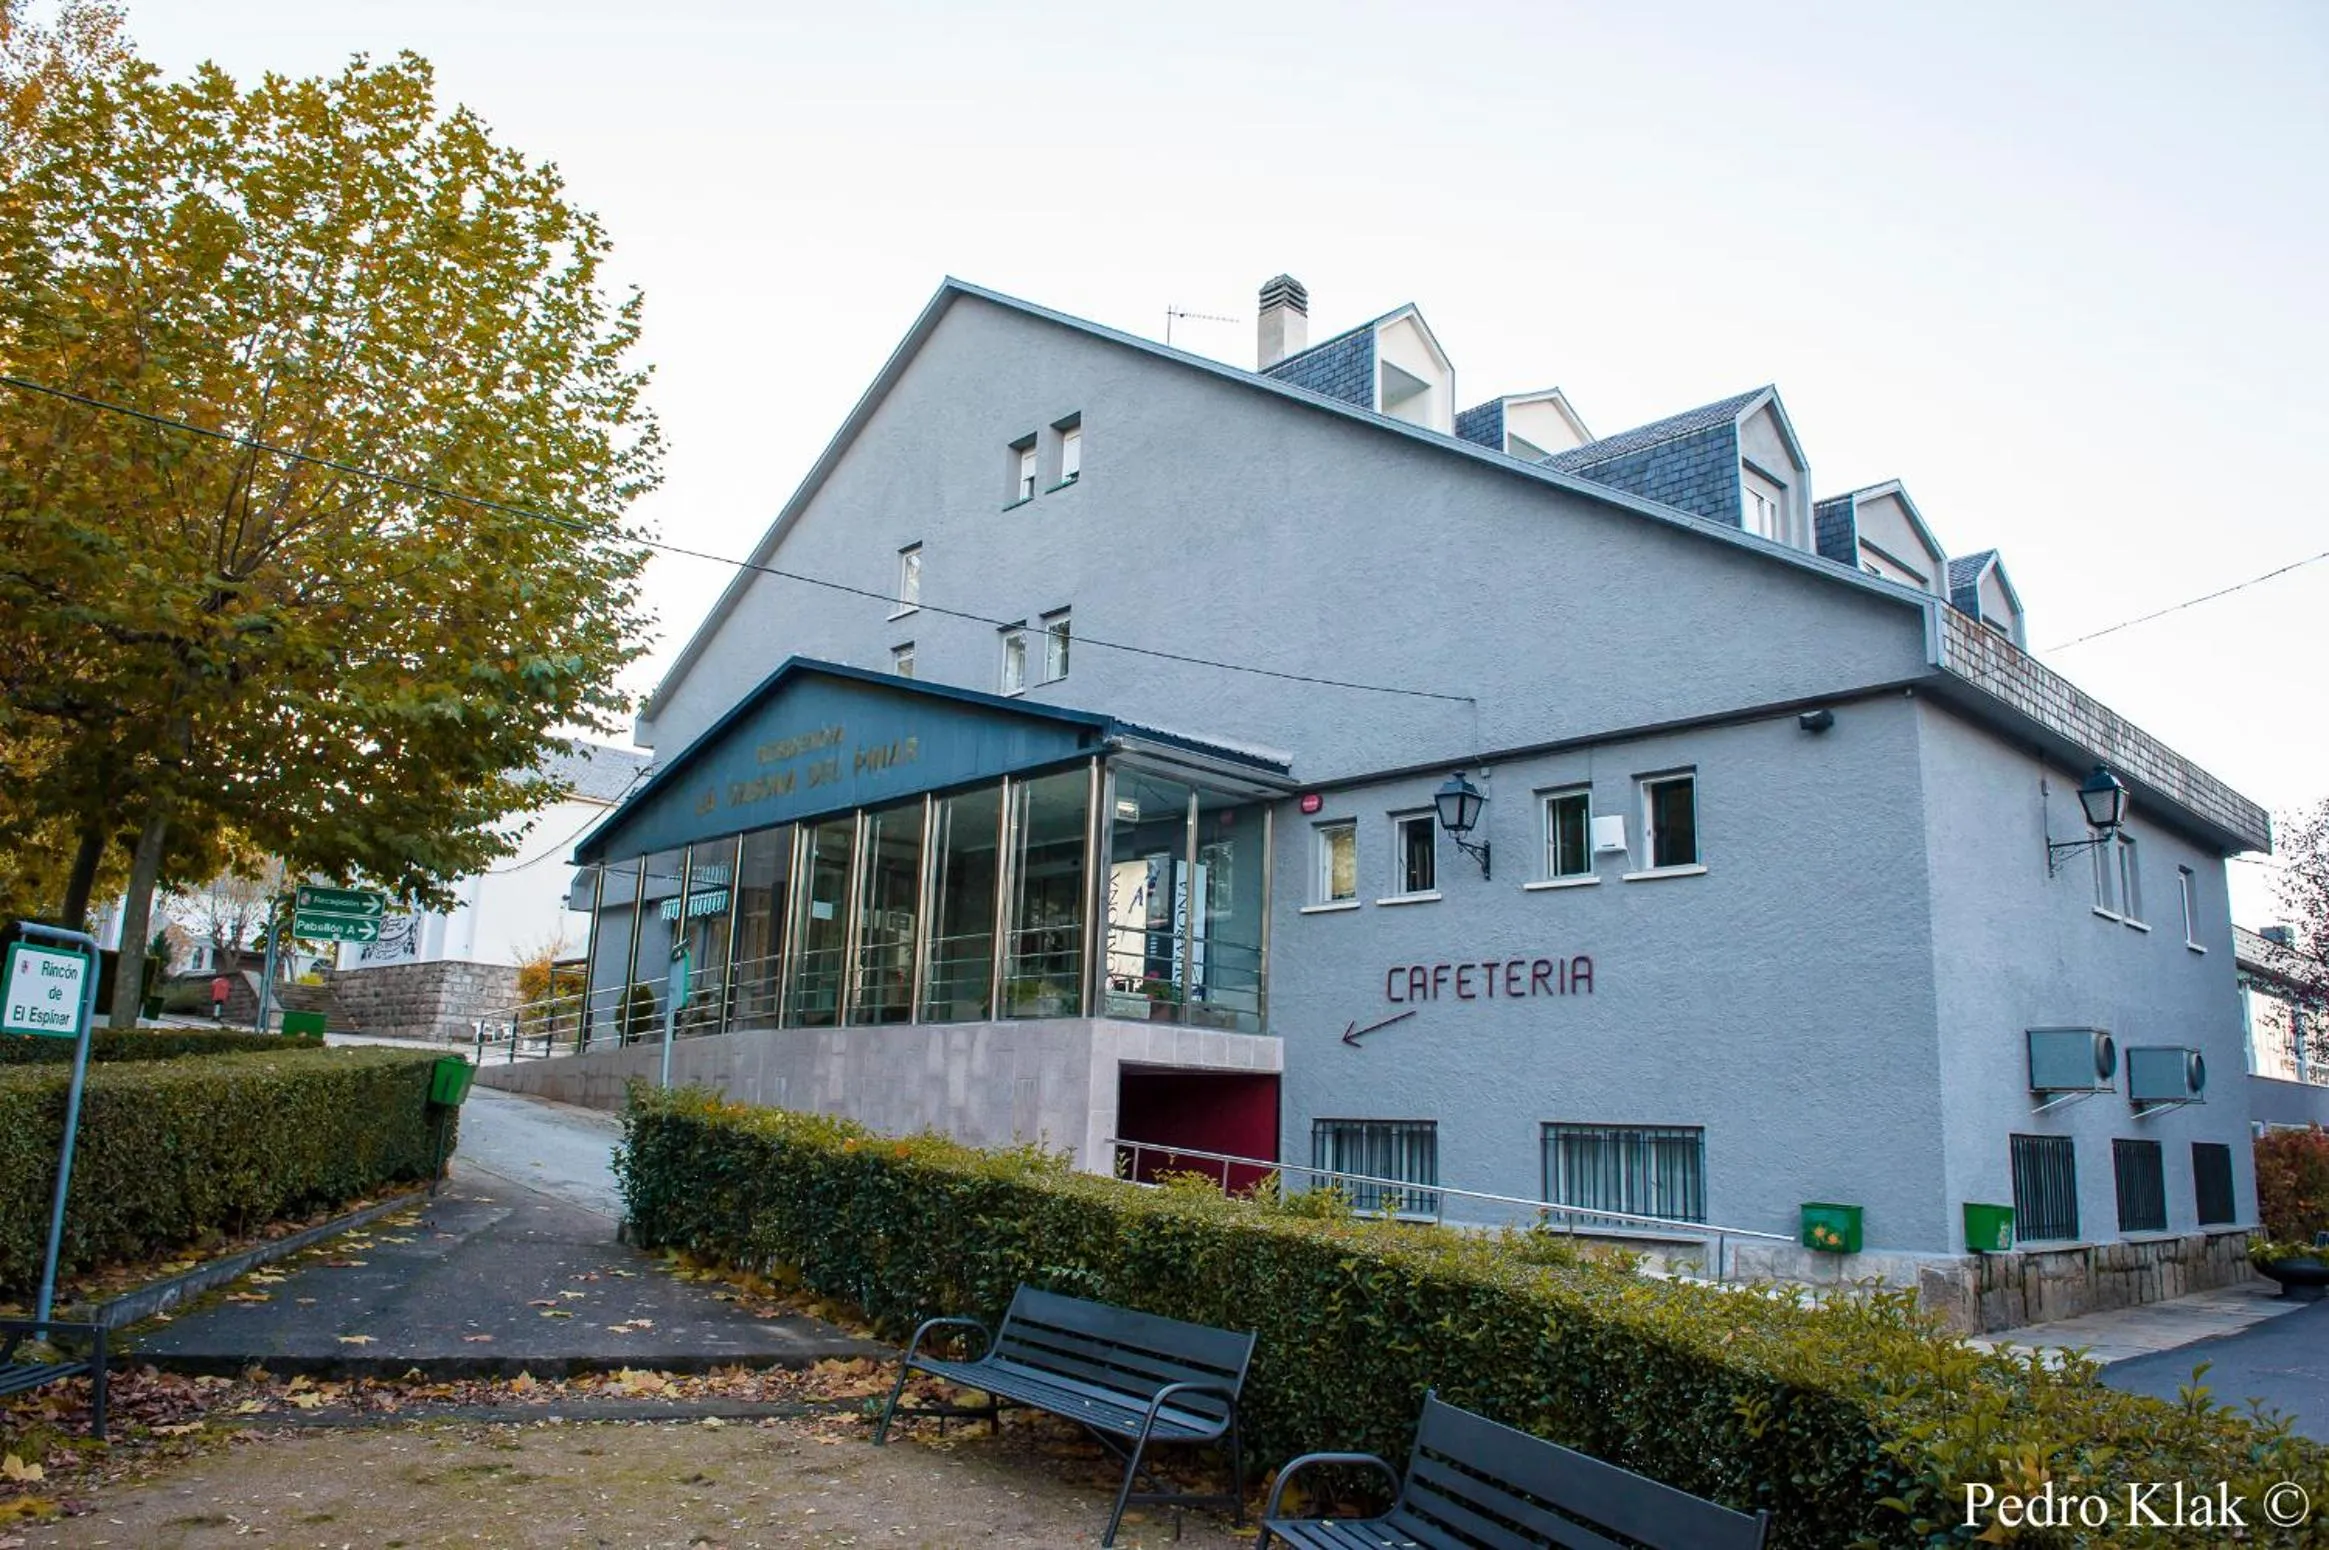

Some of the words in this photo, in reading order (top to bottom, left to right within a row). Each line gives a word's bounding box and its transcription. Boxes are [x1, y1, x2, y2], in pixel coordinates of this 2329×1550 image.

[346, 925, 356, 935] A
[41, 960, 78, 980] Rincón
[1387, 955, 1594, 1003] CAFETERIA
[48, 985, 63, 1001] de
[13, 1005, 26, 1022] El
[29, 1006, 71, 1026] Espinar
